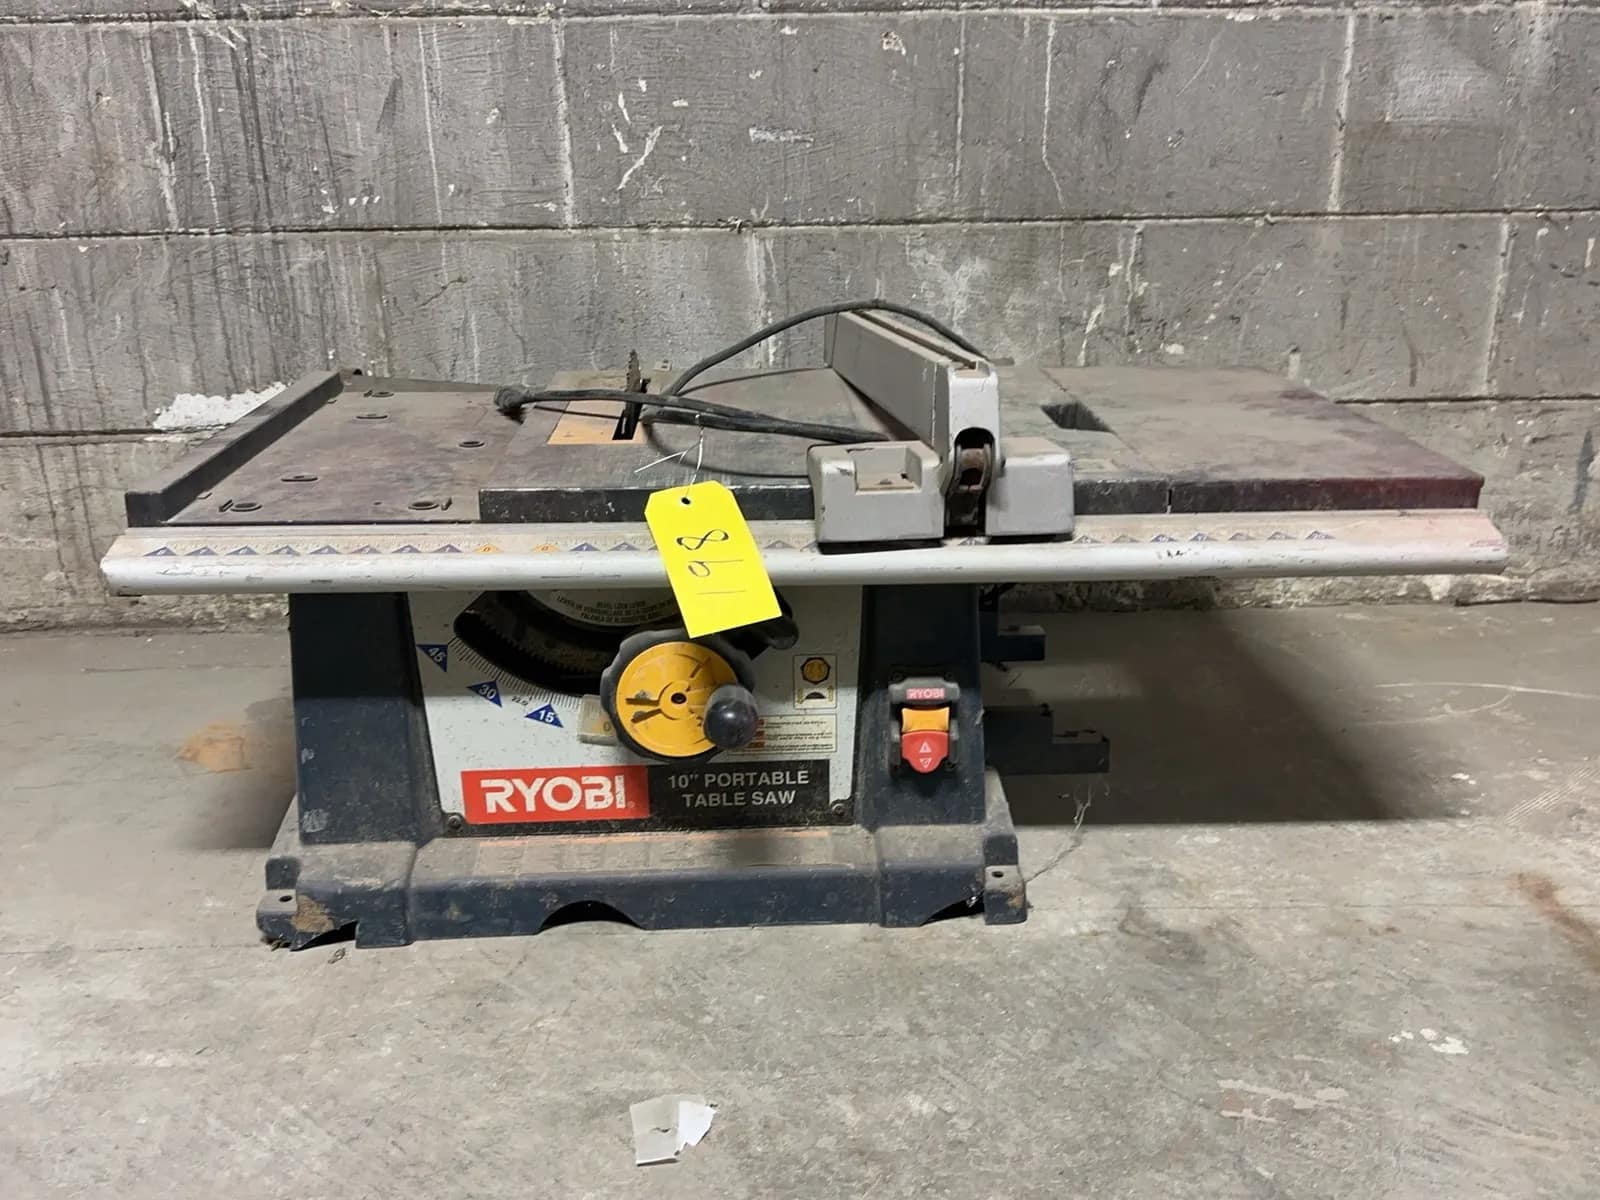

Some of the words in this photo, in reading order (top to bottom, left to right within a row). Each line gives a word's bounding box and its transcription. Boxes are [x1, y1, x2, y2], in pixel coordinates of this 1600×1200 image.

[428, 647, 446, 662] 45
[478, 684, 496, 700] 30
[907, 688, 945, 699] RYOBI
[539, 710, 554, 723] 15
[668, 774, 699, 789] 10"
[704, 770, 809, 788] PORTABLE
[480, 774, 626, 813] RYOBI
[682, 792, 746, 808] TABLE
[751, 790, 796, 806] SAW
